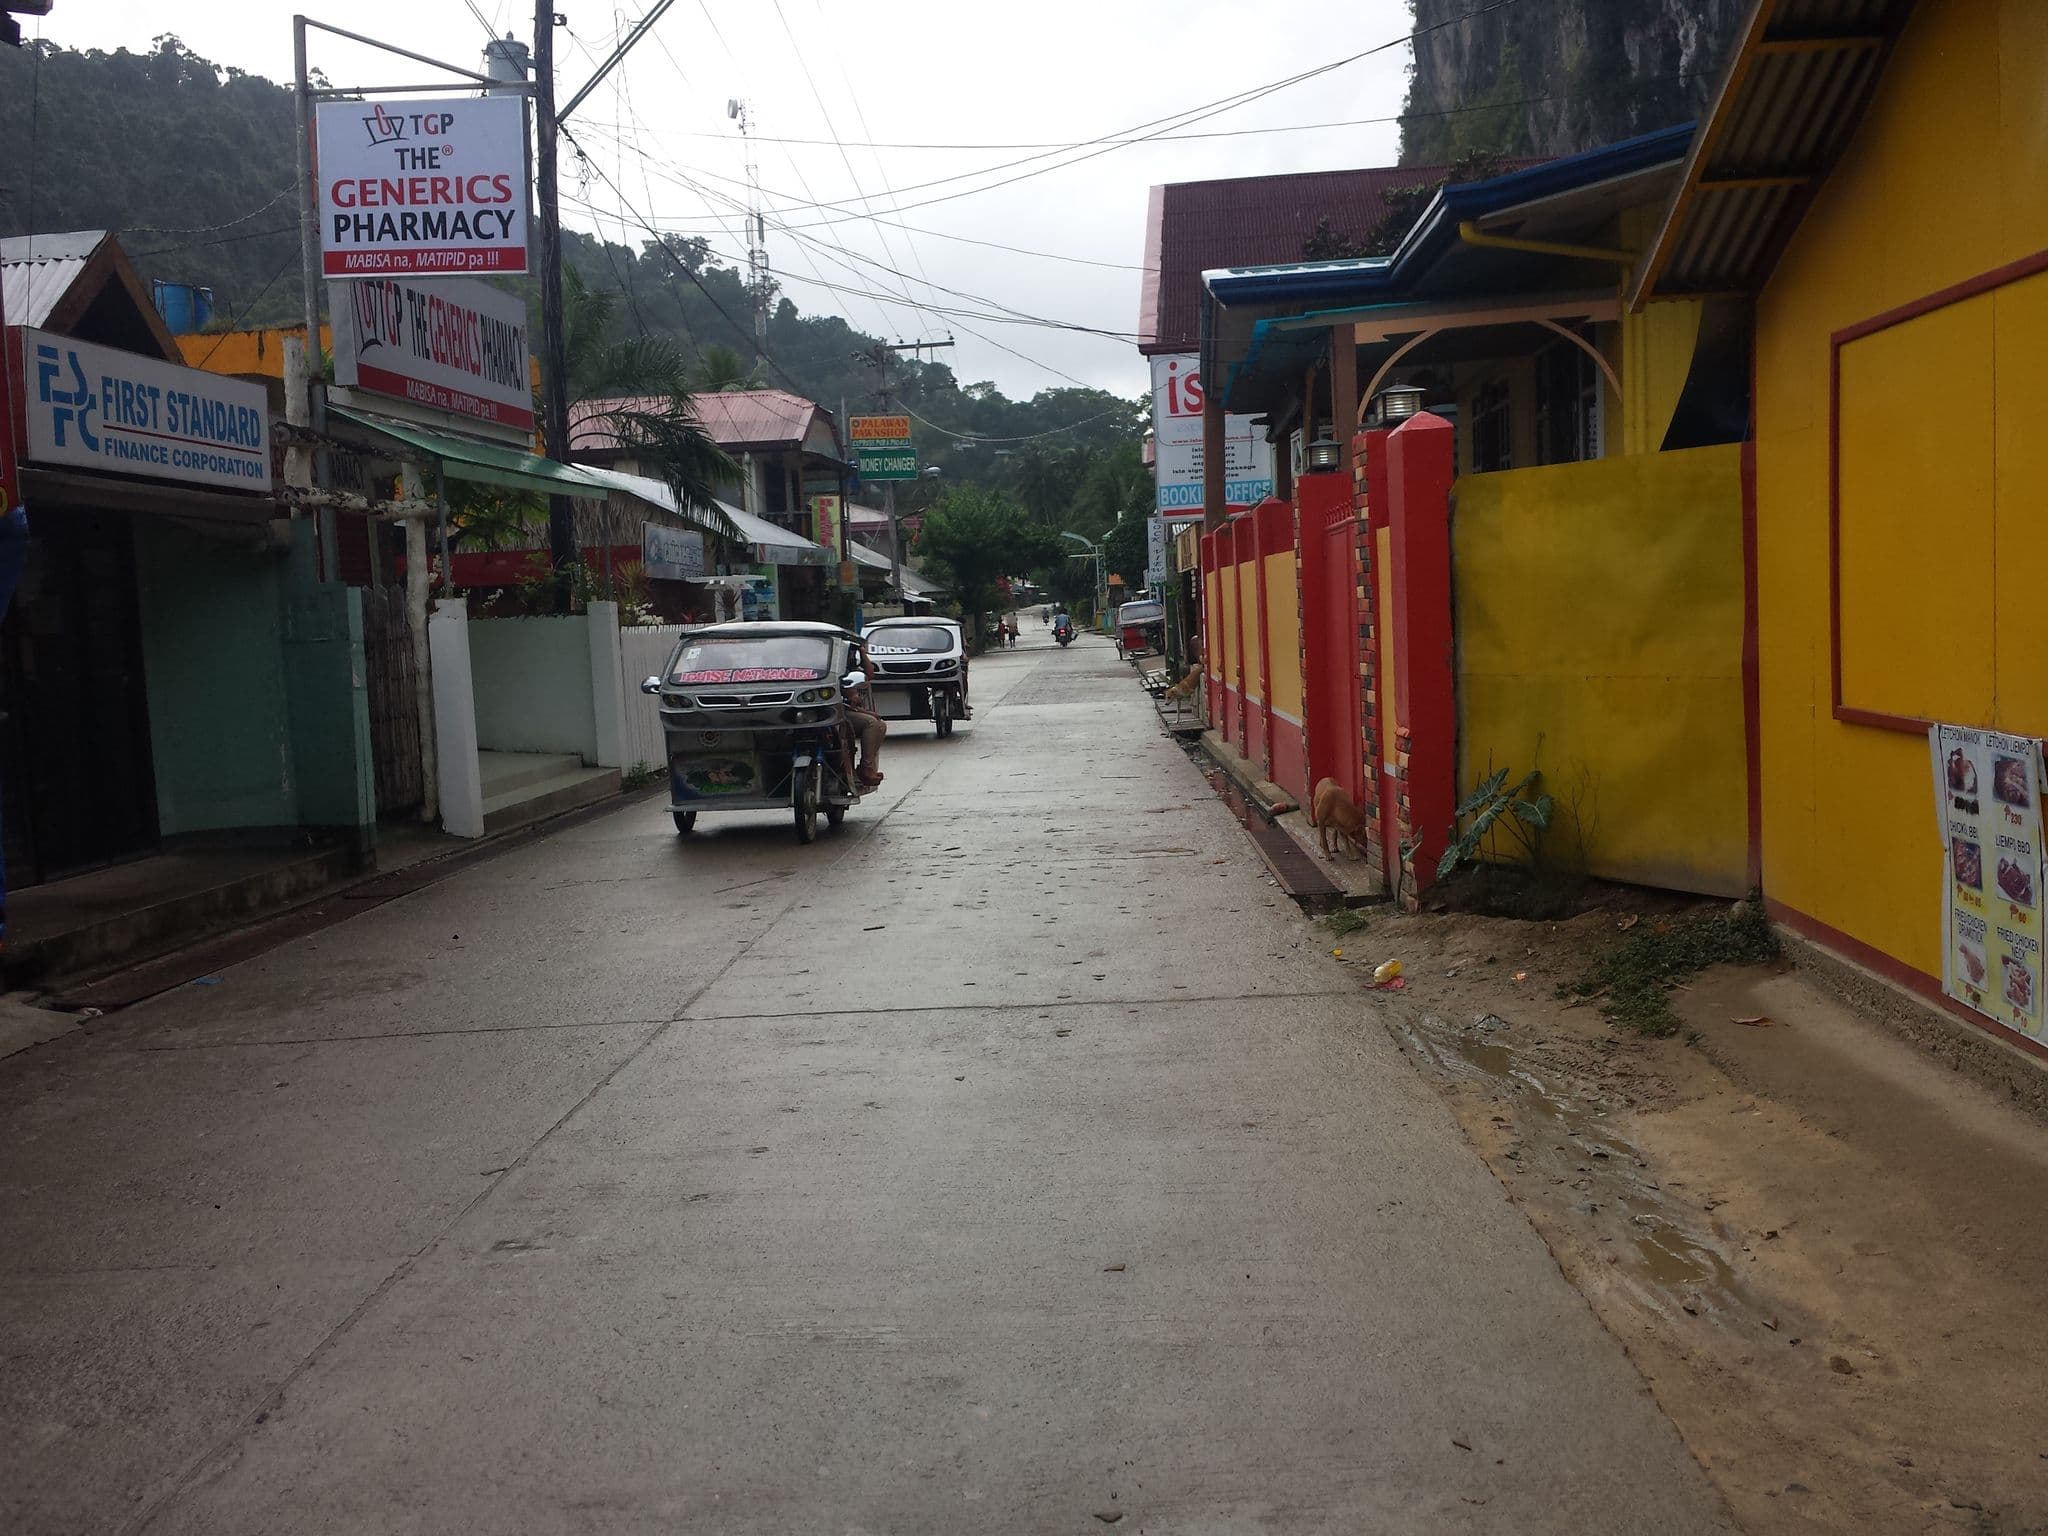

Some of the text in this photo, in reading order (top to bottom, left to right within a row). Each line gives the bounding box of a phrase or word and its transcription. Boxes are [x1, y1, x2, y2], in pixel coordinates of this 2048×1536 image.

[409, 113, 454, 136] TGP
[395, 146, 440, 171] THE
[331, 174, 513, 209] GENERICS
[334, 209, 516, 243] PHARMACY
[345, 251, 391, 269] MABISA
[393, 254, 413, 270] na,
[416, 251, 467, 268] MATIPID
[468, 253, 484, 270] pa
[407, 288, 430, 360] THE
[428, 294, 482, 377] GENERICS
[480, 313, 525, 392] PHARMACY
[406, 380, 437, 405] MABISA
[451, 392, 480, 415] MATIPID
[101, 375, 261, 449] FIRST STANDARD
[861, 418, 908, 428] PALAWAN
[852, 428, 908, 438] PAWNSHOP
[103, 437, 264, 480] FINANCE CORPORATION
[859, 456, 916, 472] MONEY CHANGER
[1996, 926, 2039, 952] FRIED CHICKEN
